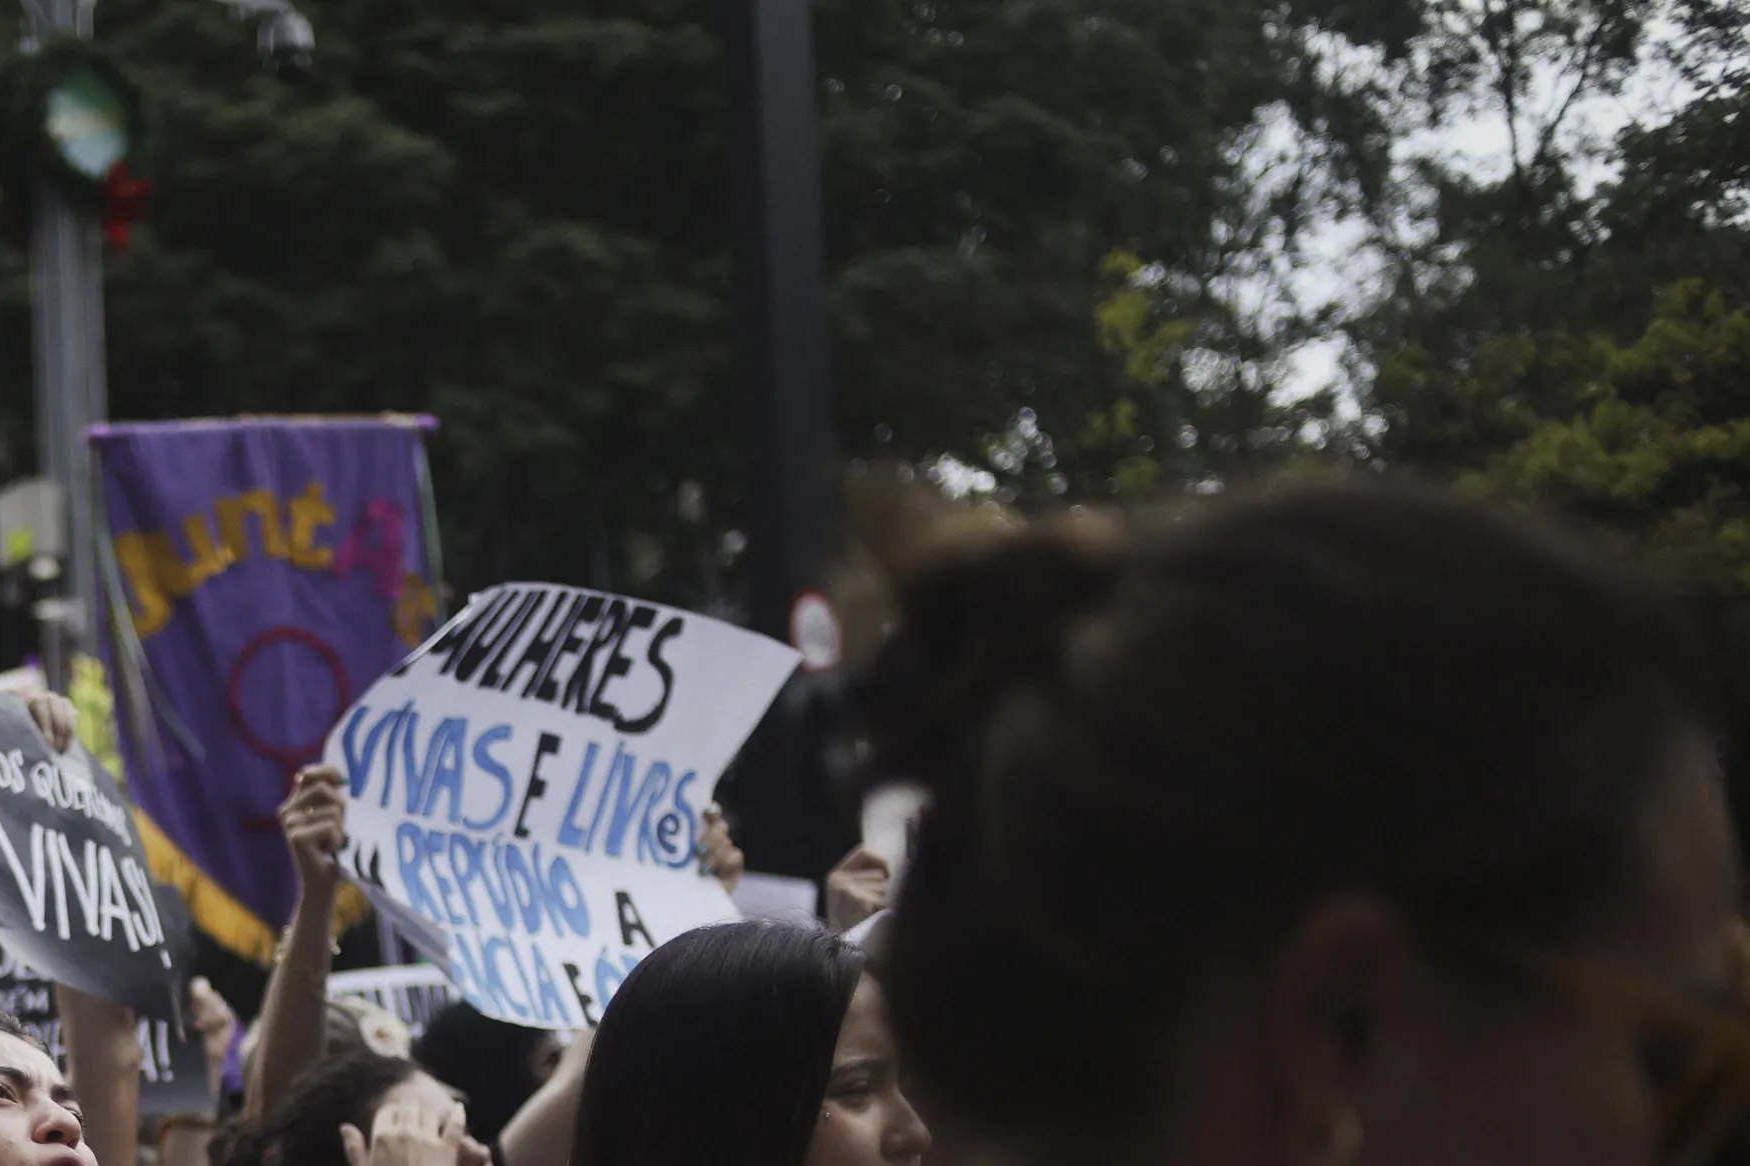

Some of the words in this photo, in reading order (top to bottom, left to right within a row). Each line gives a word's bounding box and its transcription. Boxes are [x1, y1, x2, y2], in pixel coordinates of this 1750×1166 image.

[342, 700, 513, 831] VIVAS
[513, 732, 562, 838] E
[615, 891, 655, 949] A
